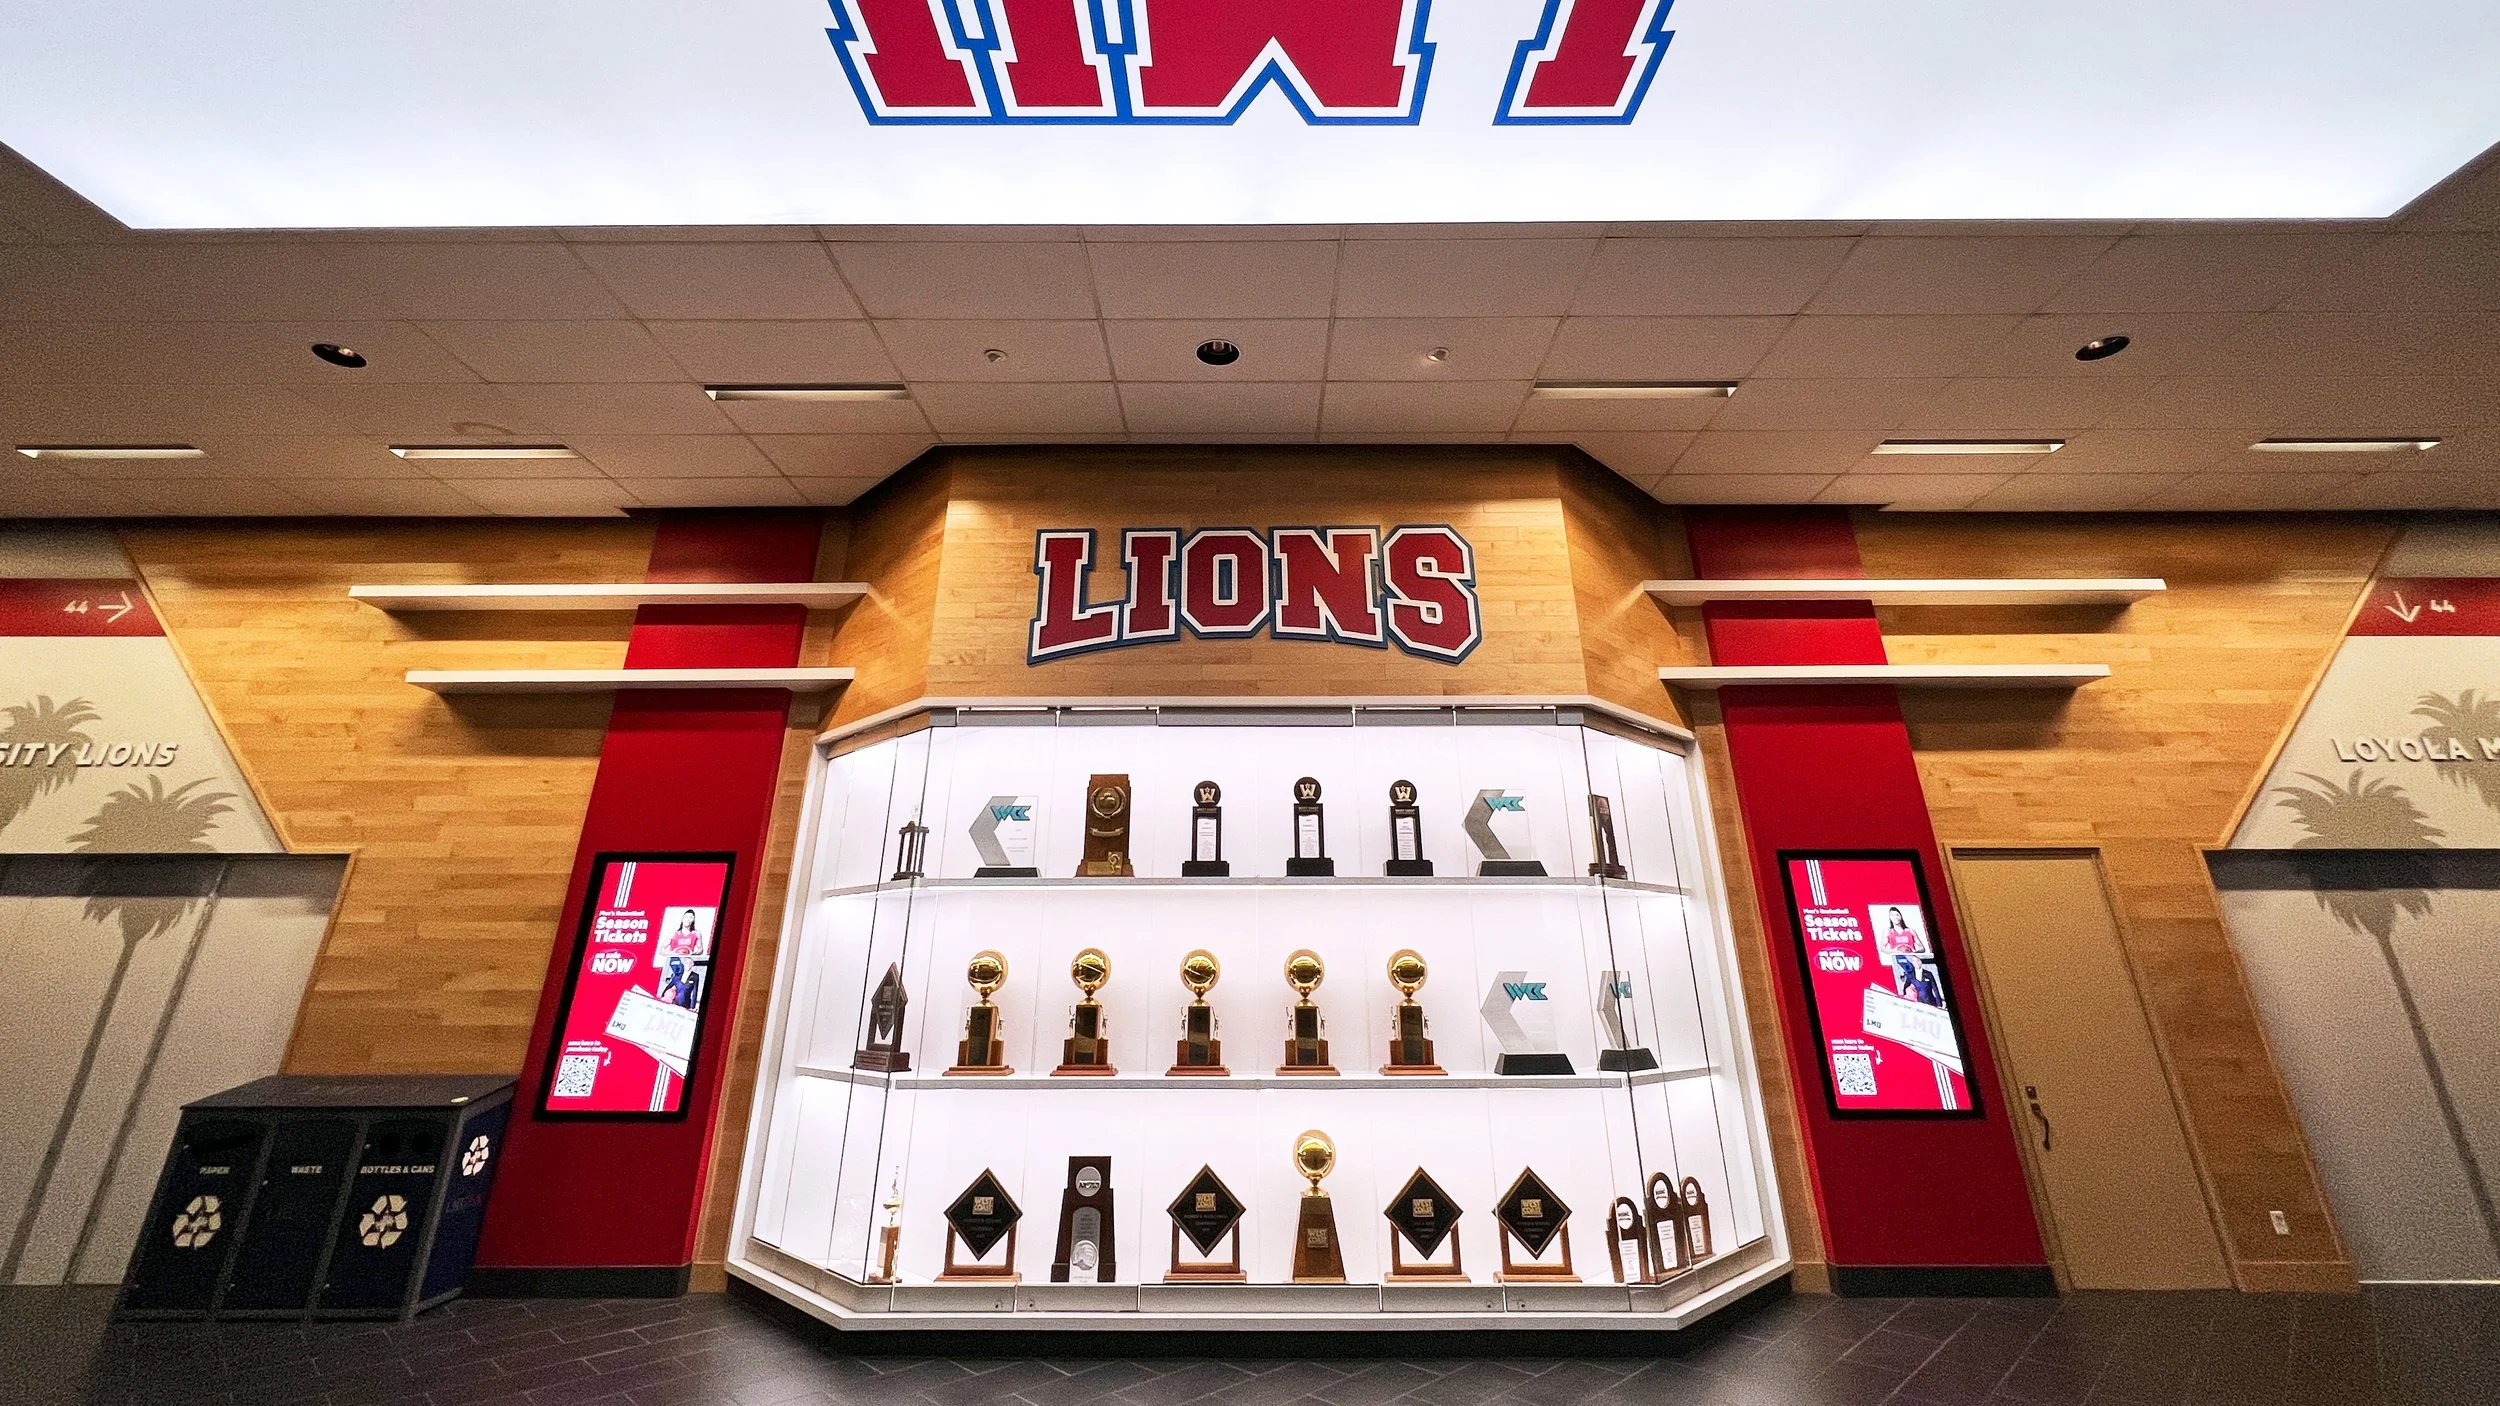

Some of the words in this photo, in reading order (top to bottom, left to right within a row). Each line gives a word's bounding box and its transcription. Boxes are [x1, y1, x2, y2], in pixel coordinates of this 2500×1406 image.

[1027, 524, 1482, 666] LIONS
[76, 742, 179, 767] LIONS
[2332, 737, 2474, 762] LOYOLA
[595, 916, 649, 930] Season
[1804, 914, 1859, 928] Season
[593, 929, 648, 944] Tickets
[1806, 927, 1863, 942] Tickets
[591, 958, 635, 973] NOW
[1819, 956, 1860, 972] NOW
[291, 1165, 323, 1174] WASTE
[360, 1165, 402, 1174] BOTTLES
[411, 1165, 435, 1174] CANS
